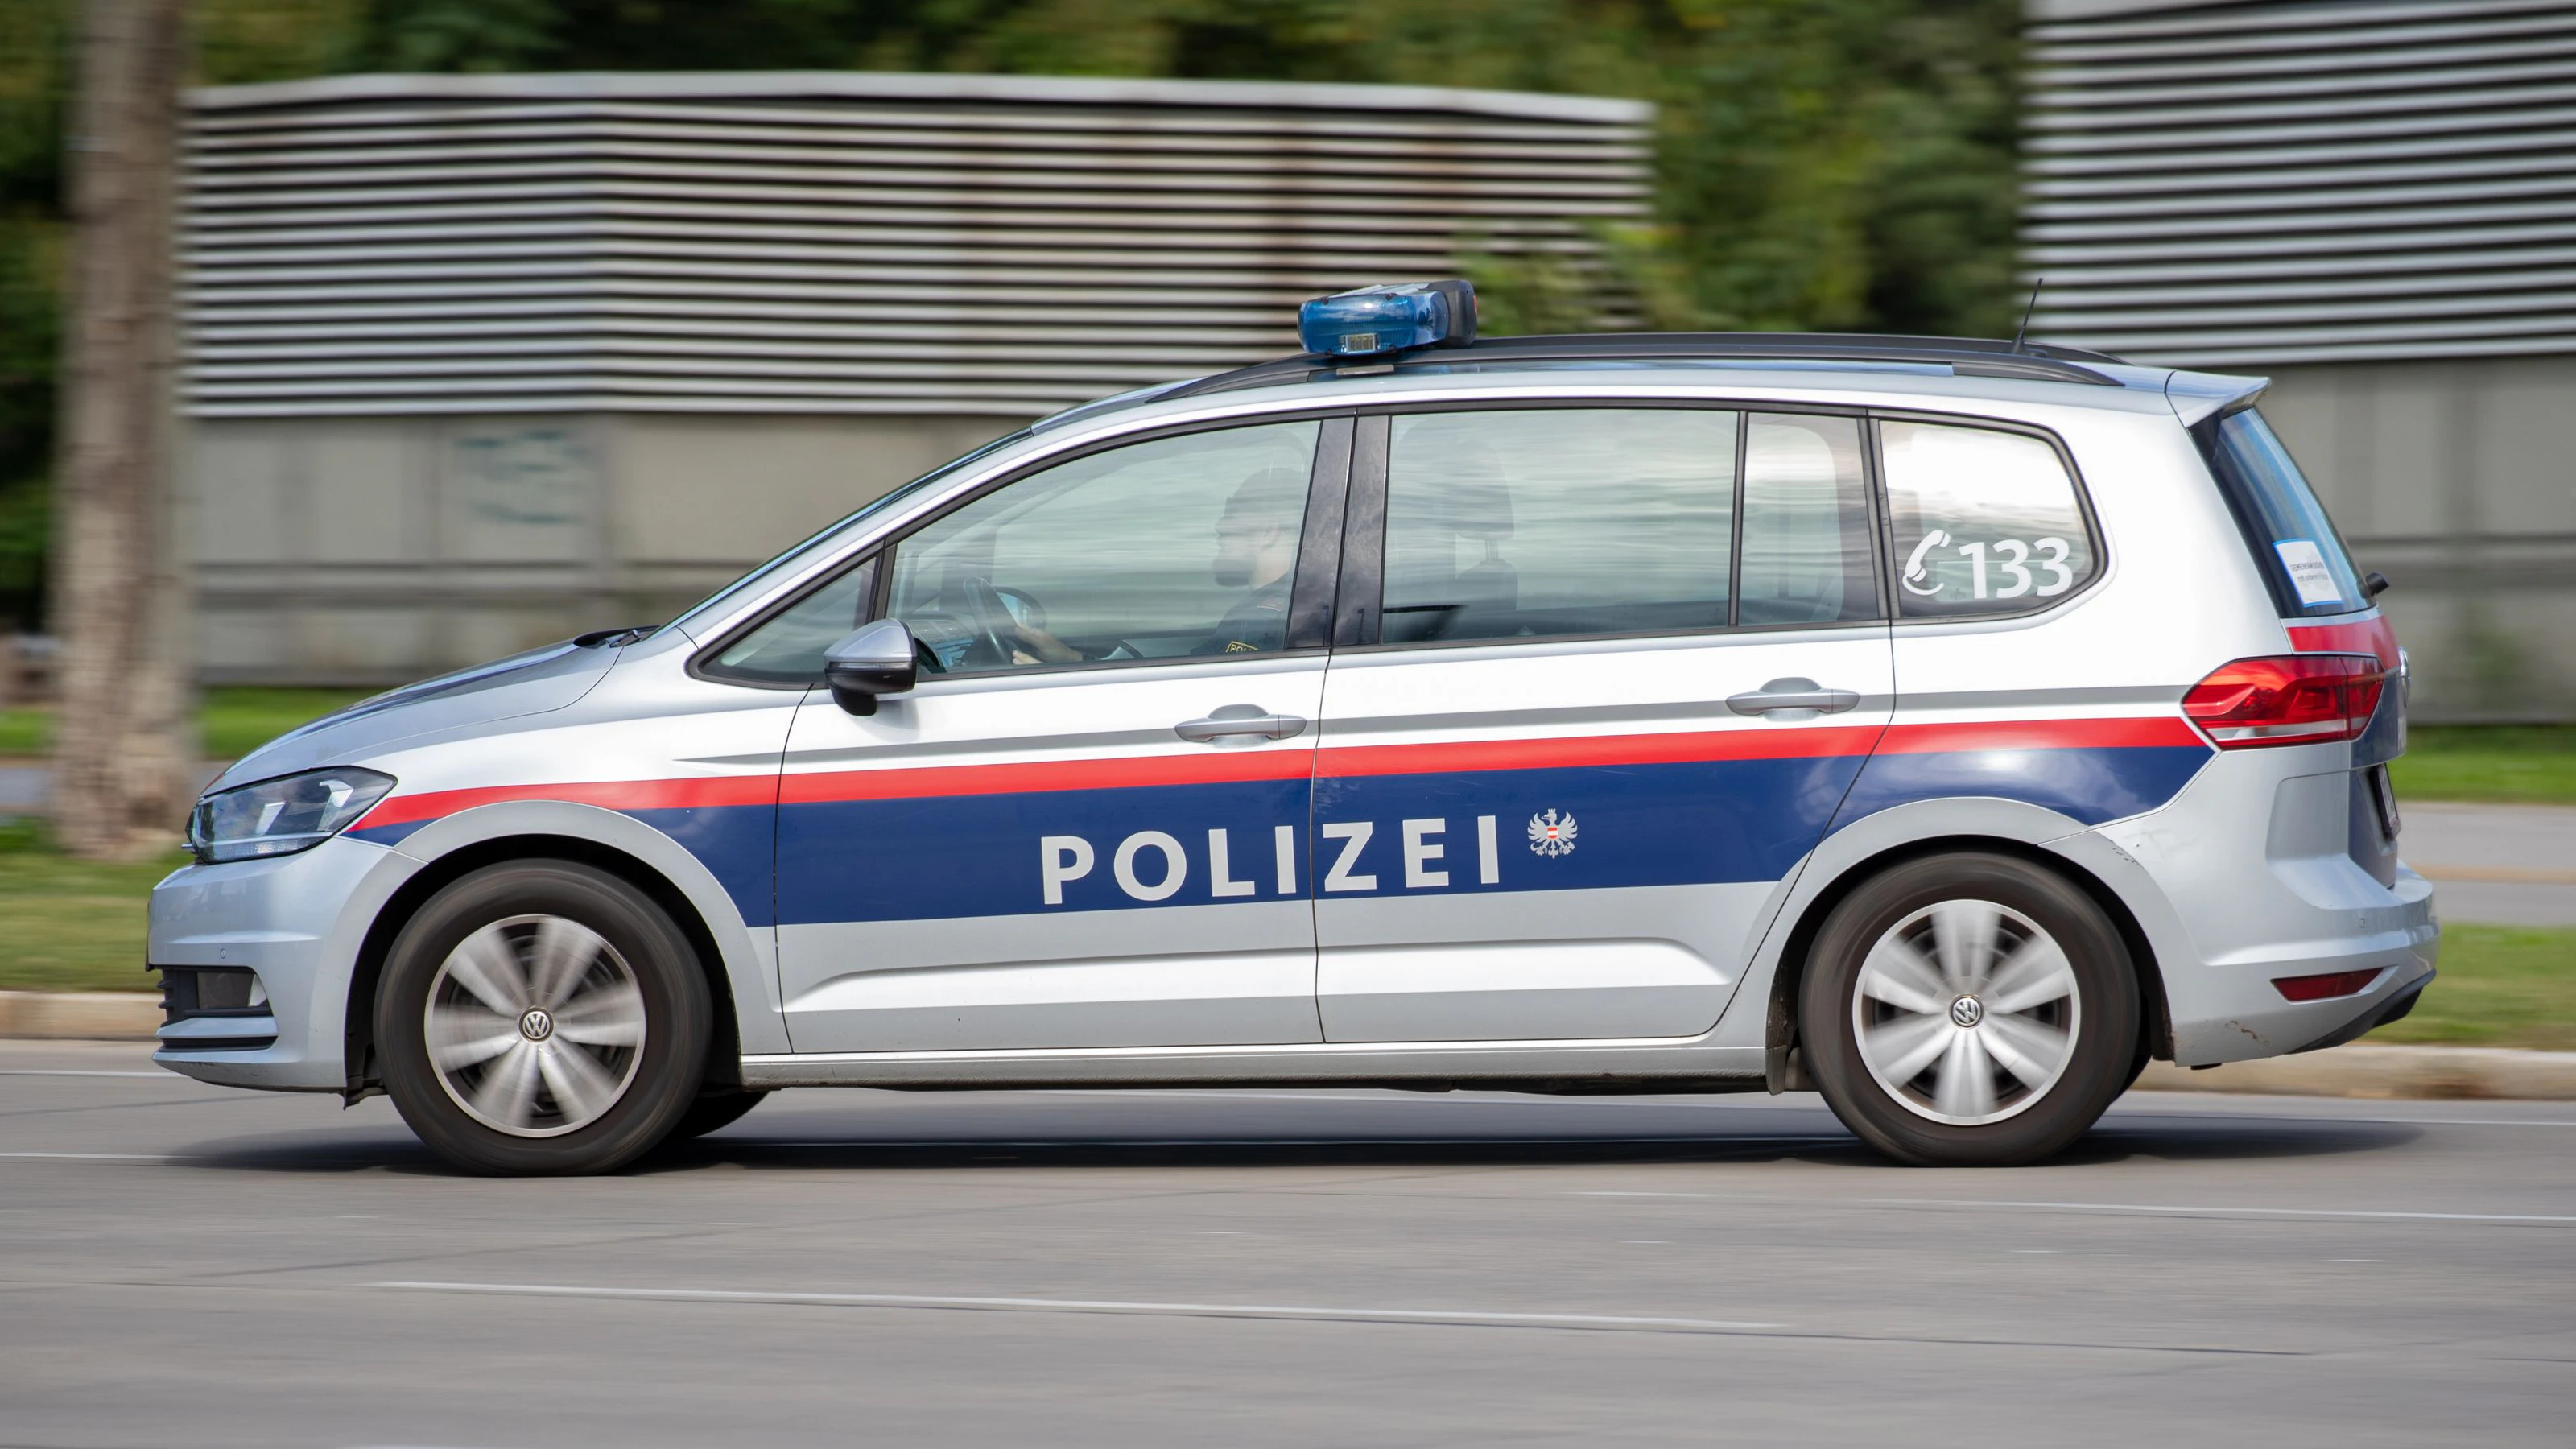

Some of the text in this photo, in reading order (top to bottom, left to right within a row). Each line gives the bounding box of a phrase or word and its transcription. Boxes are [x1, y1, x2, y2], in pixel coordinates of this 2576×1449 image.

[1959, 537, 2073, 599] 133
[1041, 815, 1499, 905] POLIZEI
[523, 1011, 549, 1038] VW
[1953, 997, 1980, 1026] VW
